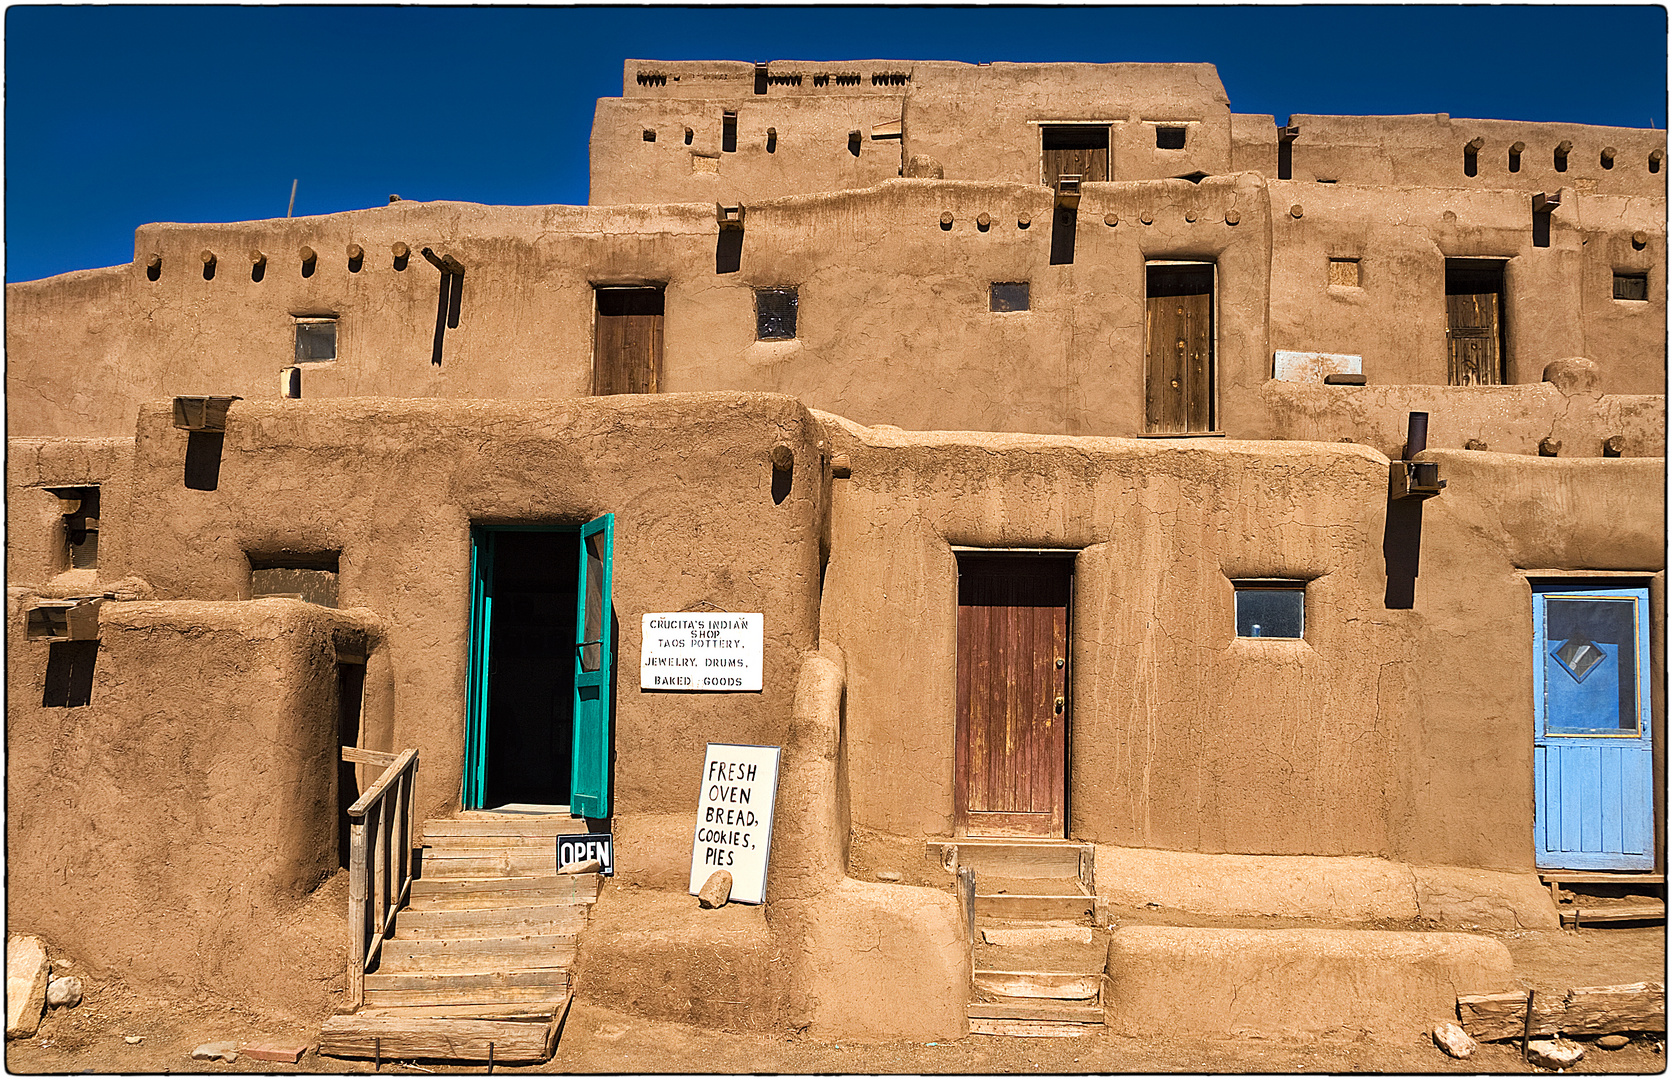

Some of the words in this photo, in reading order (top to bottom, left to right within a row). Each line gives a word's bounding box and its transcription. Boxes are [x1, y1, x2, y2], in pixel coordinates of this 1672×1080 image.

[650, 620, 705, 629] CRUCITA'S
[708, 620, 748, 629] INDIAN
[690, 630, 720, 638] SHOP
[658, 639, 685, 648] TAOS
[654, 676, 691, 685] BAKED
[703, 677, 743, 686] GOODS
[708, 761, 757, 781] FRESH
[708, 785, 751, 804] OVEN
[706, 807, 759, 827] BREAD,
[698, 828, 756, 850] COOKIES,
[561, 841, 610, 867] OPEN
[705, 847, 734, 866] PIES
